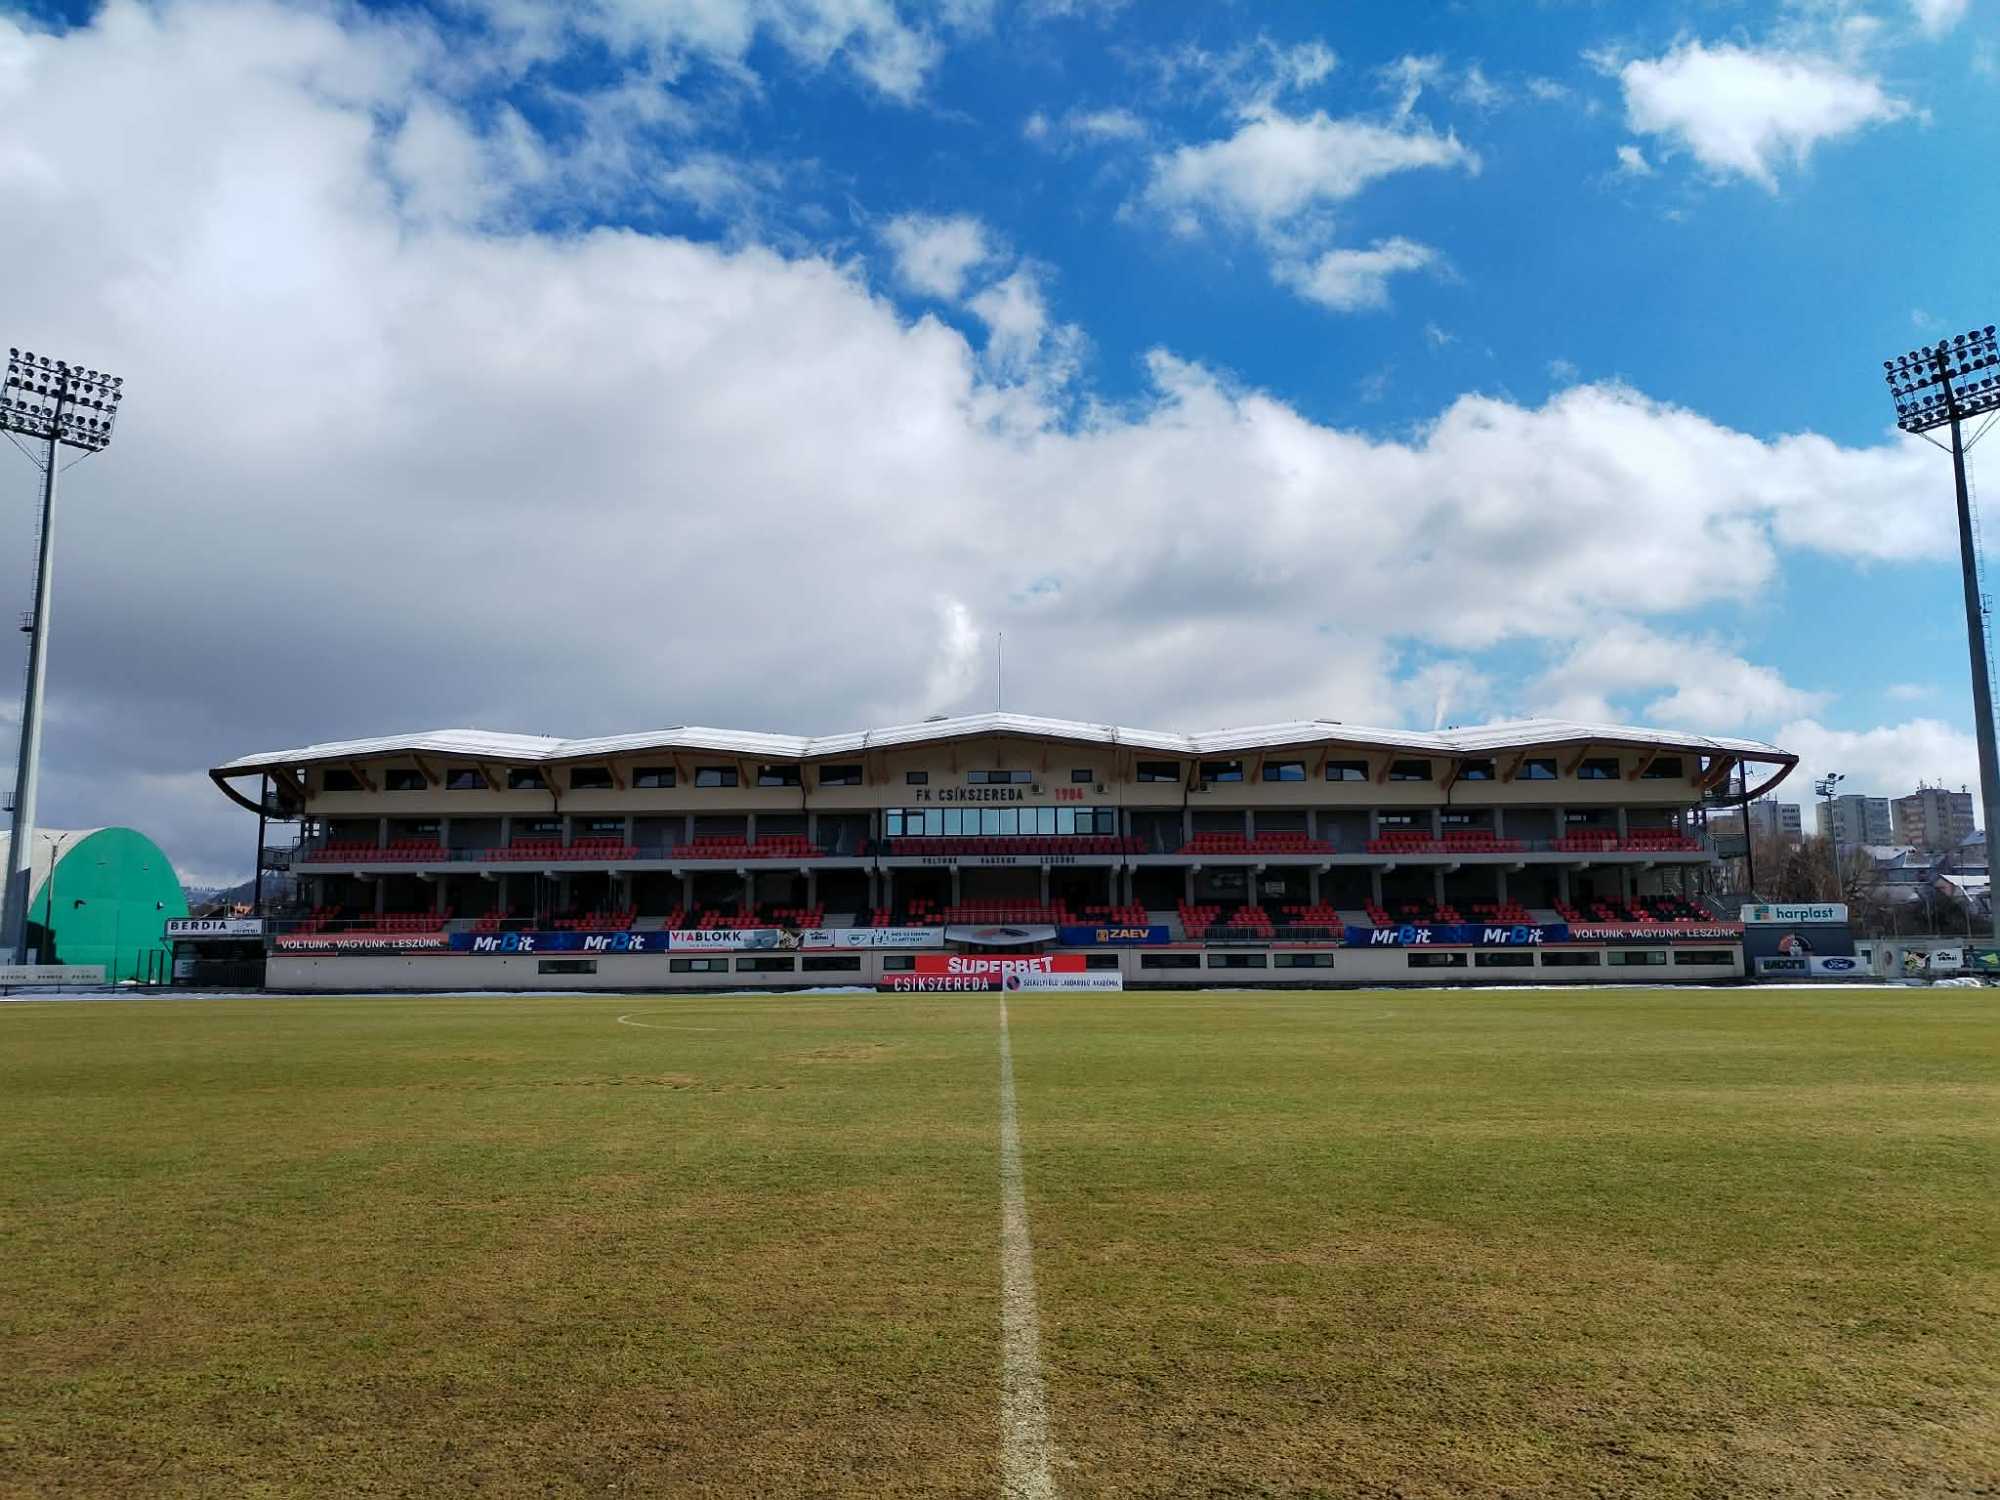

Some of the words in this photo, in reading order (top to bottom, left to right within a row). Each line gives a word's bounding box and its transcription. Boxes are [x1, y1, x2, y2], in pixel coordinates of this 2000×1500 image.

[916, 789, 931, 801] FK
[938, 786, 1023, 801] CSÍKSZEREDA
[1776, 907, 1833, 921] harplast
[170, 921, 227, 930] BERDIA
[1110, 929, 1150, 938] ZAEV
[473, 933, 534, 951] MrBit
[584, 932, 645, 950] MrBit
[671, 931, 742, 942] VIABLOKK
[1370, 925, 1432, 944] MrBit
[1483, 926, 1544, 944] MrBit
[948, 956, 1053, 974] SUPERBET
[894, 975, 989, 991] CSÍKSZEREDA
